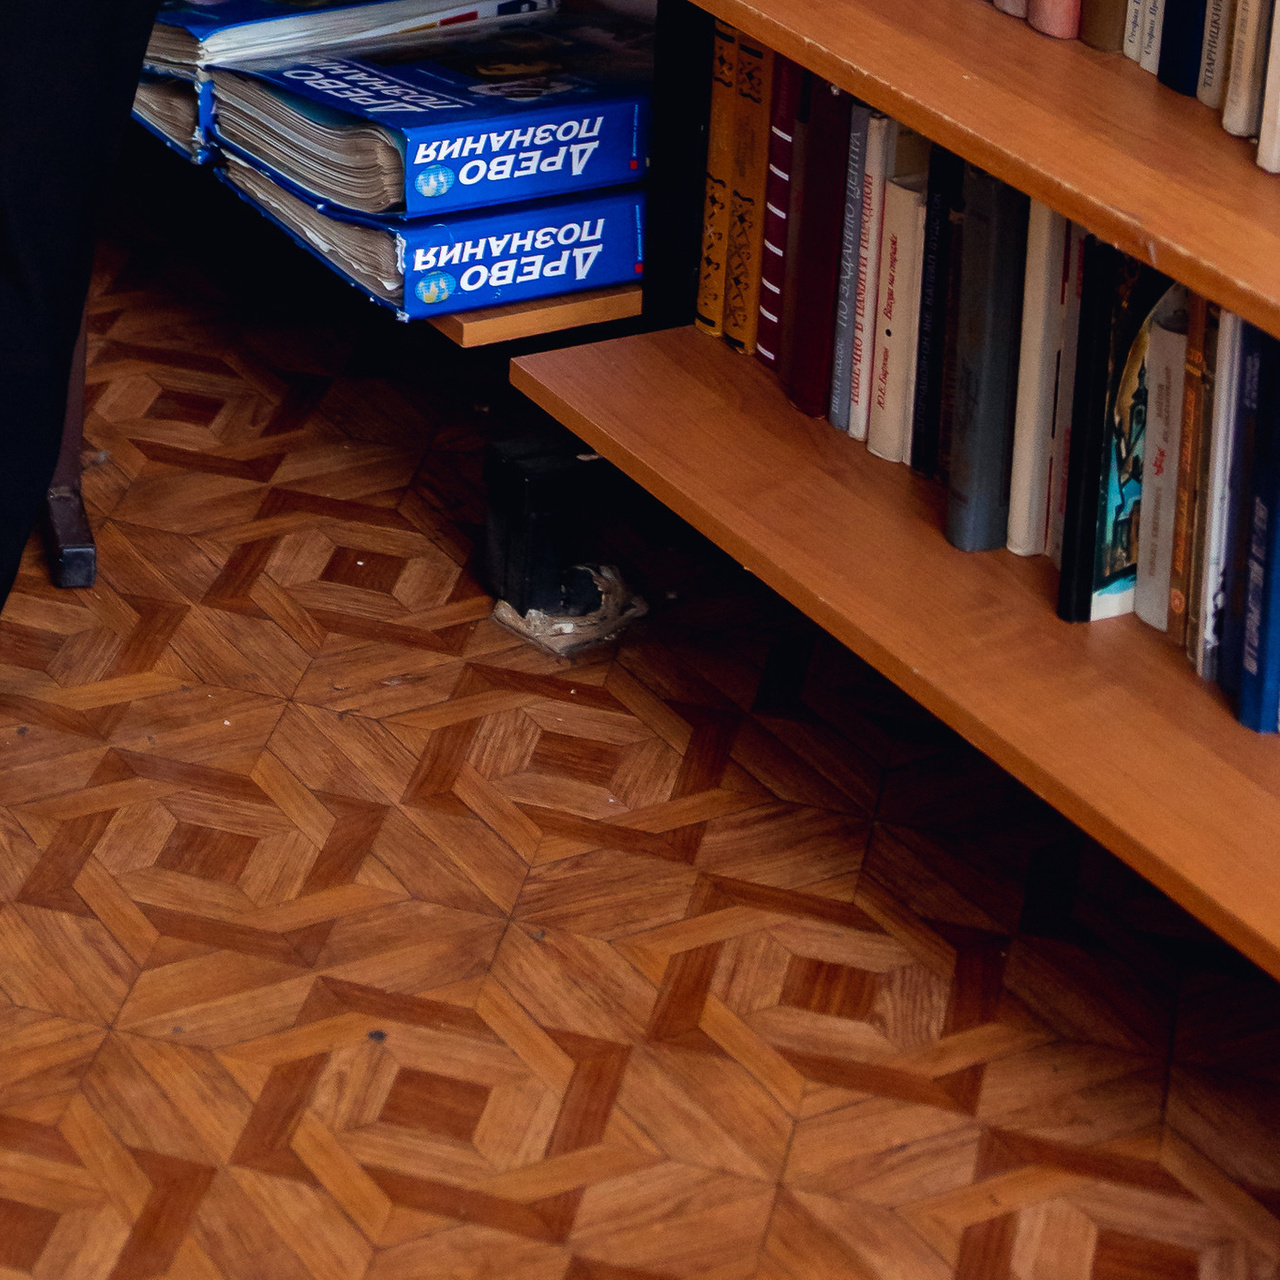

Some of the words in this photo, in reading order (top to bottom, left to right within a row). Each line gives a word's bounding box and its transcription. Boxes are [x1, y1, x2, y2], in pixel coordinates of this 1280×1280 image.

[1128, 8, 1140, 44] Стефан
[1144, 19, 1156, 55] Стефан
[414, 116, 604, 166] ПОЗНАНИЯ
[458, 140, 600, 186] ДРЕВО
[847, 131, 860, 199] ЦЕНТРА
[859, 173, 874, 250] НАРОДНОЙ
[414, 218, 606, 270] ПОЗНАНИЯ
[460, 243, 603, 292] ДРЕВО
[840, 203, 856, 298] ЗАДАНИЮ
[856, 256, 869, 314] ПАМЯТИ
[882, 287, 894, 321] Всегда
[885, 273, 894, 286] на
[838, 300, 848, 328] ПО
[855, 320, 864, 333] В
[850, 336, 864, 405] НАВЕЧНО
